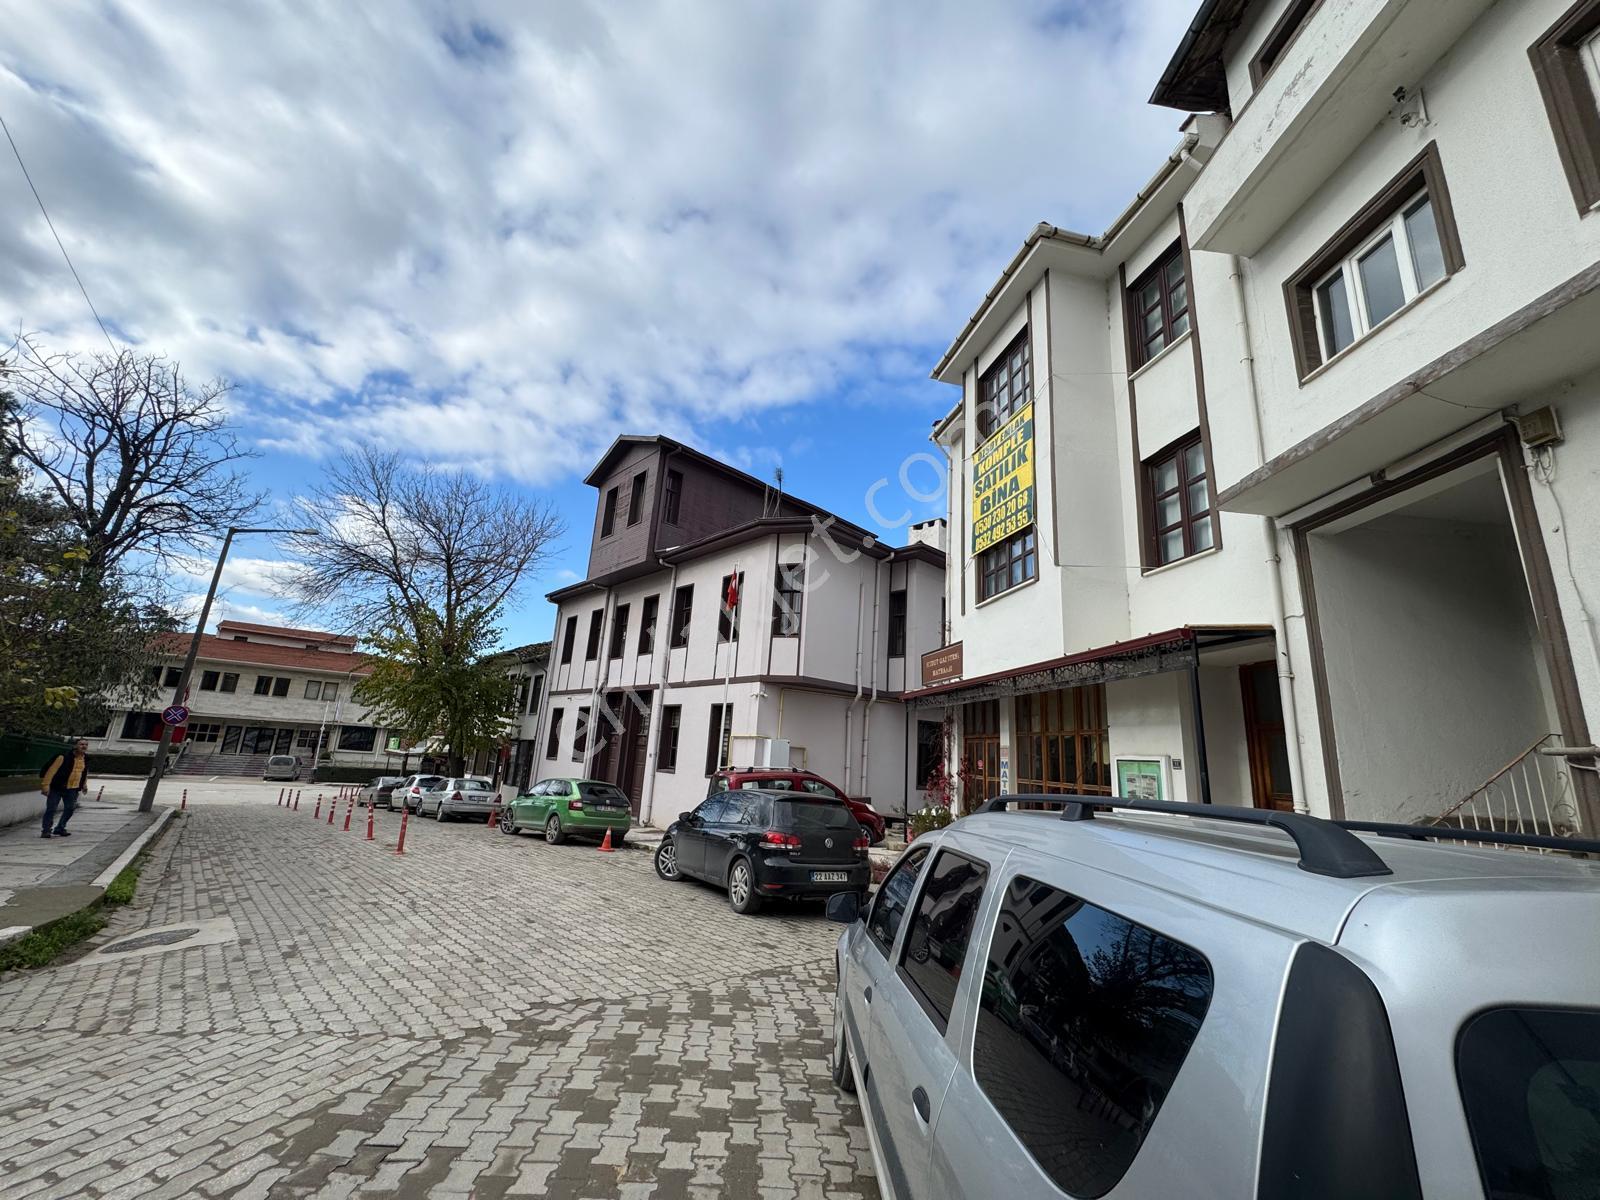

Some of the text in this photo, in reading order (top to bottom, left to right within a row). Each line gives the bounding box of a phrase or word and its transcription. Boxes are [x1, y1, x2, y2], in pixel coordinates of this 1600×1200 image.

[978, 429, 1024, 475] KOMPLE
[975, 443, 1028, 499] SATILIK
[980, 474, 1019, 515] BİNA
[1007, 497, 1016, 515] 20
[992, 520, 1005, 541] 492
[1006, 514, 1016, 533] 53
[1017, 508, 1028, 526] 55
[815, 872, 823, 881] 22
